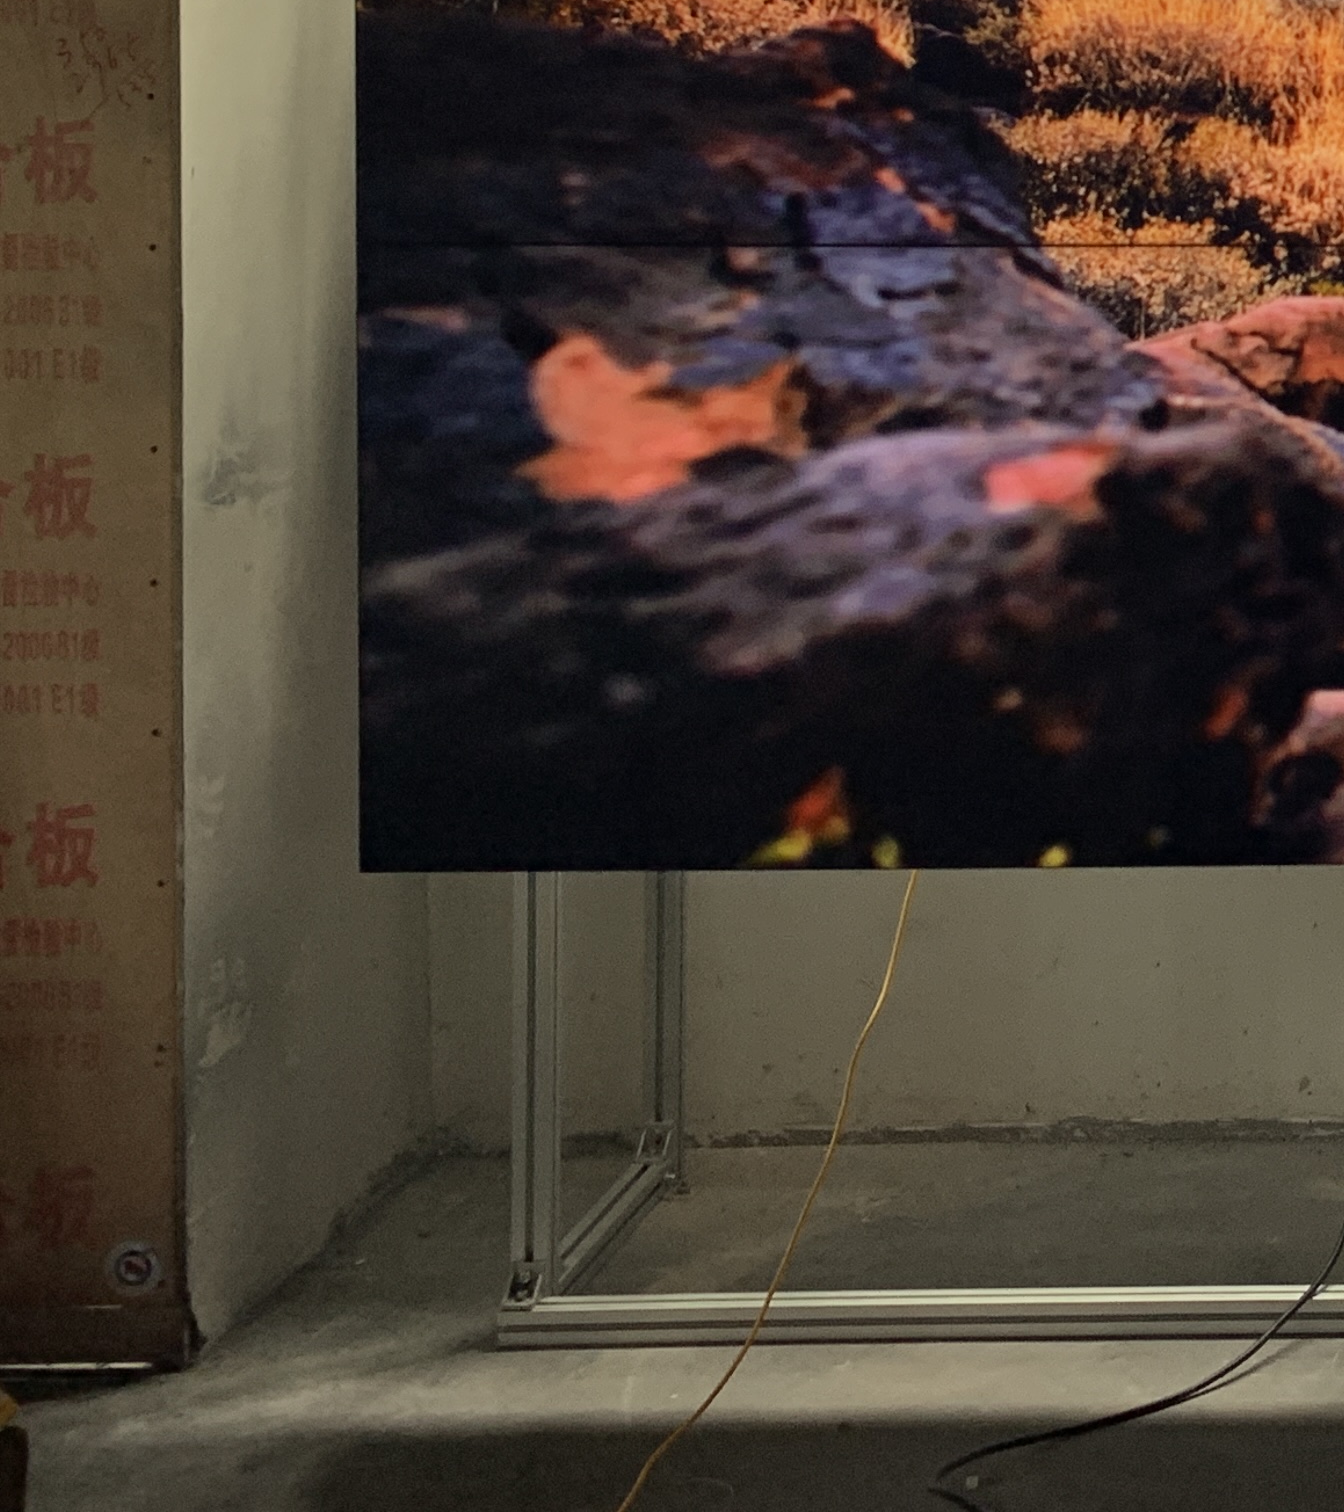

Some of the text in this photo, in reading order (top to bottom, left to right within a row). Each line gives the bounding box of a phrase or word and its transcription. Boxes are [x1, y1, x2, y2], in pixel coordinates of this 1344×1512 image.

[24, 116, 98, 204] 板
[23, 453, 98, 540] 板
[25, 802, 100, 888] 板
